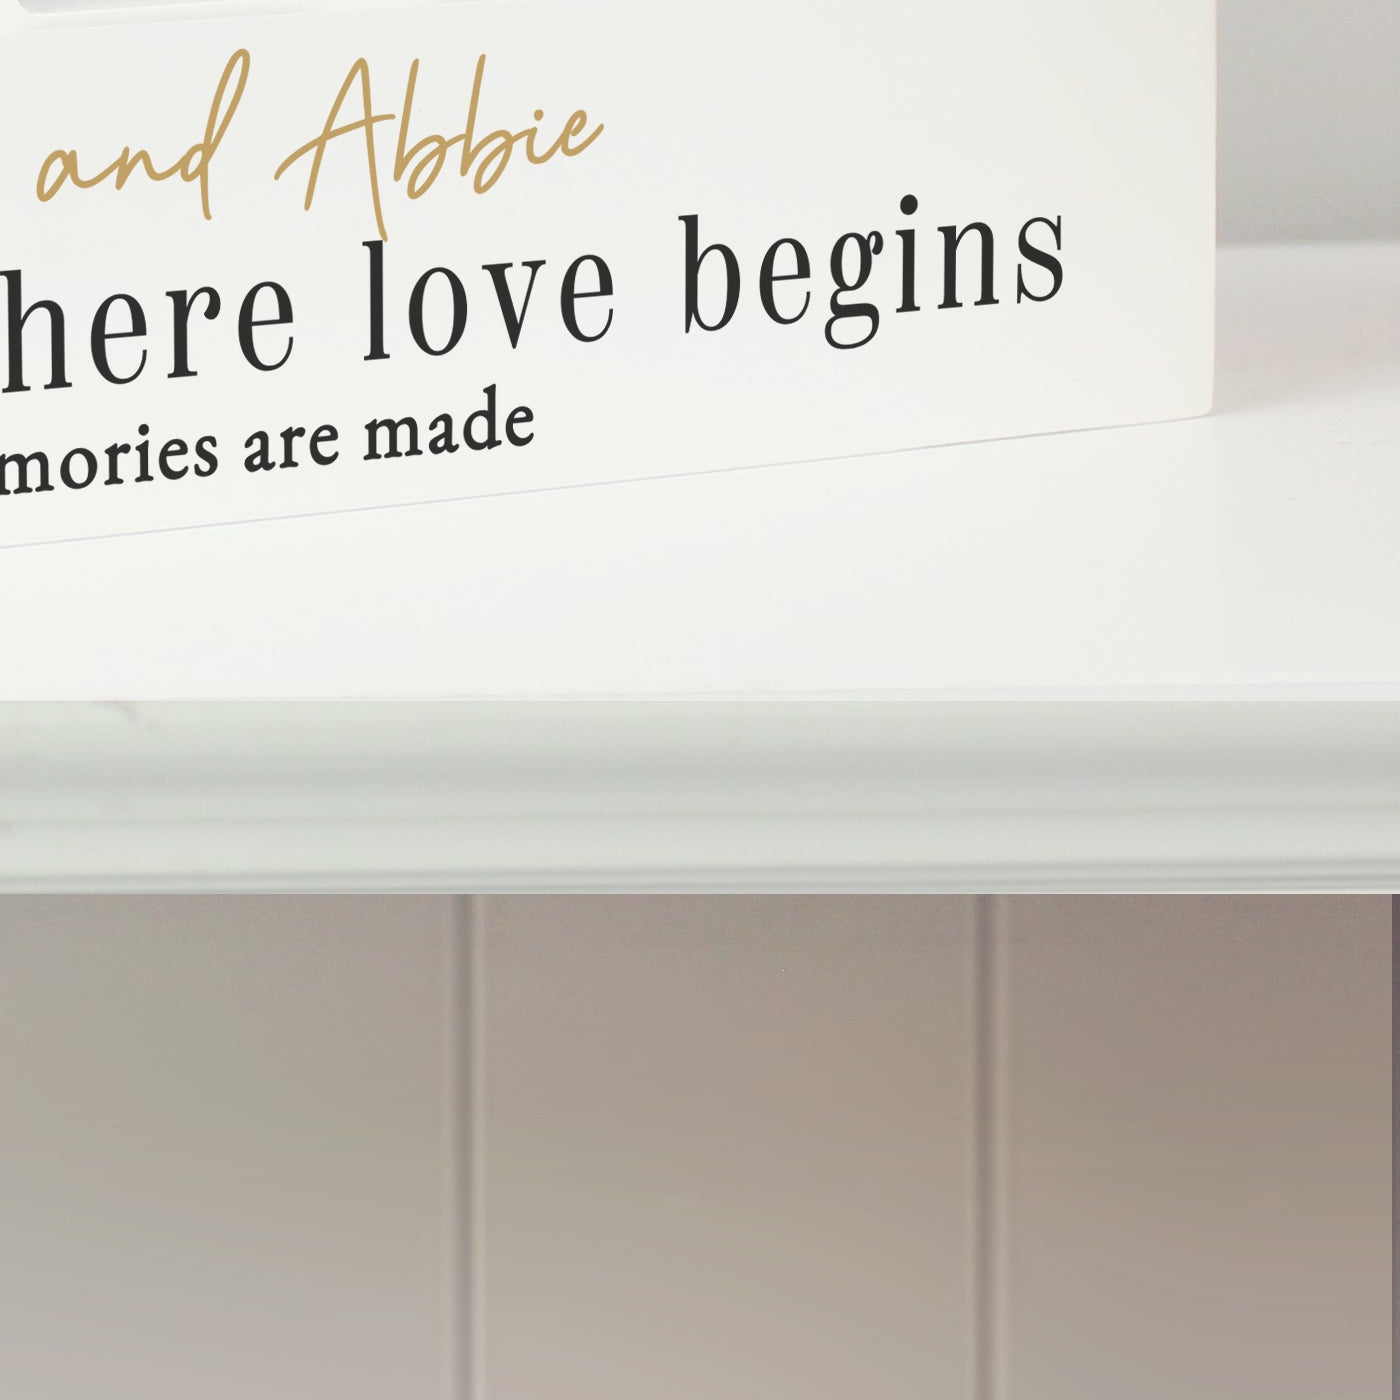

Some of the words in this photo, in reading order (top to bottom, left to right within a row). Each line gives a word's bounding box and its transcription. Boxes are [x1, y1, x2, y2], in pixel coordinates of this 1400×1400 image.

[36, 48, 251, 221] and
[273, 53, 604, 243] Abbie
[361, 239, 614, 361] love
[677, 194, 1064, 350] begins
[244, 424, 339, 473] are
[363, 383, 535, 461] made
